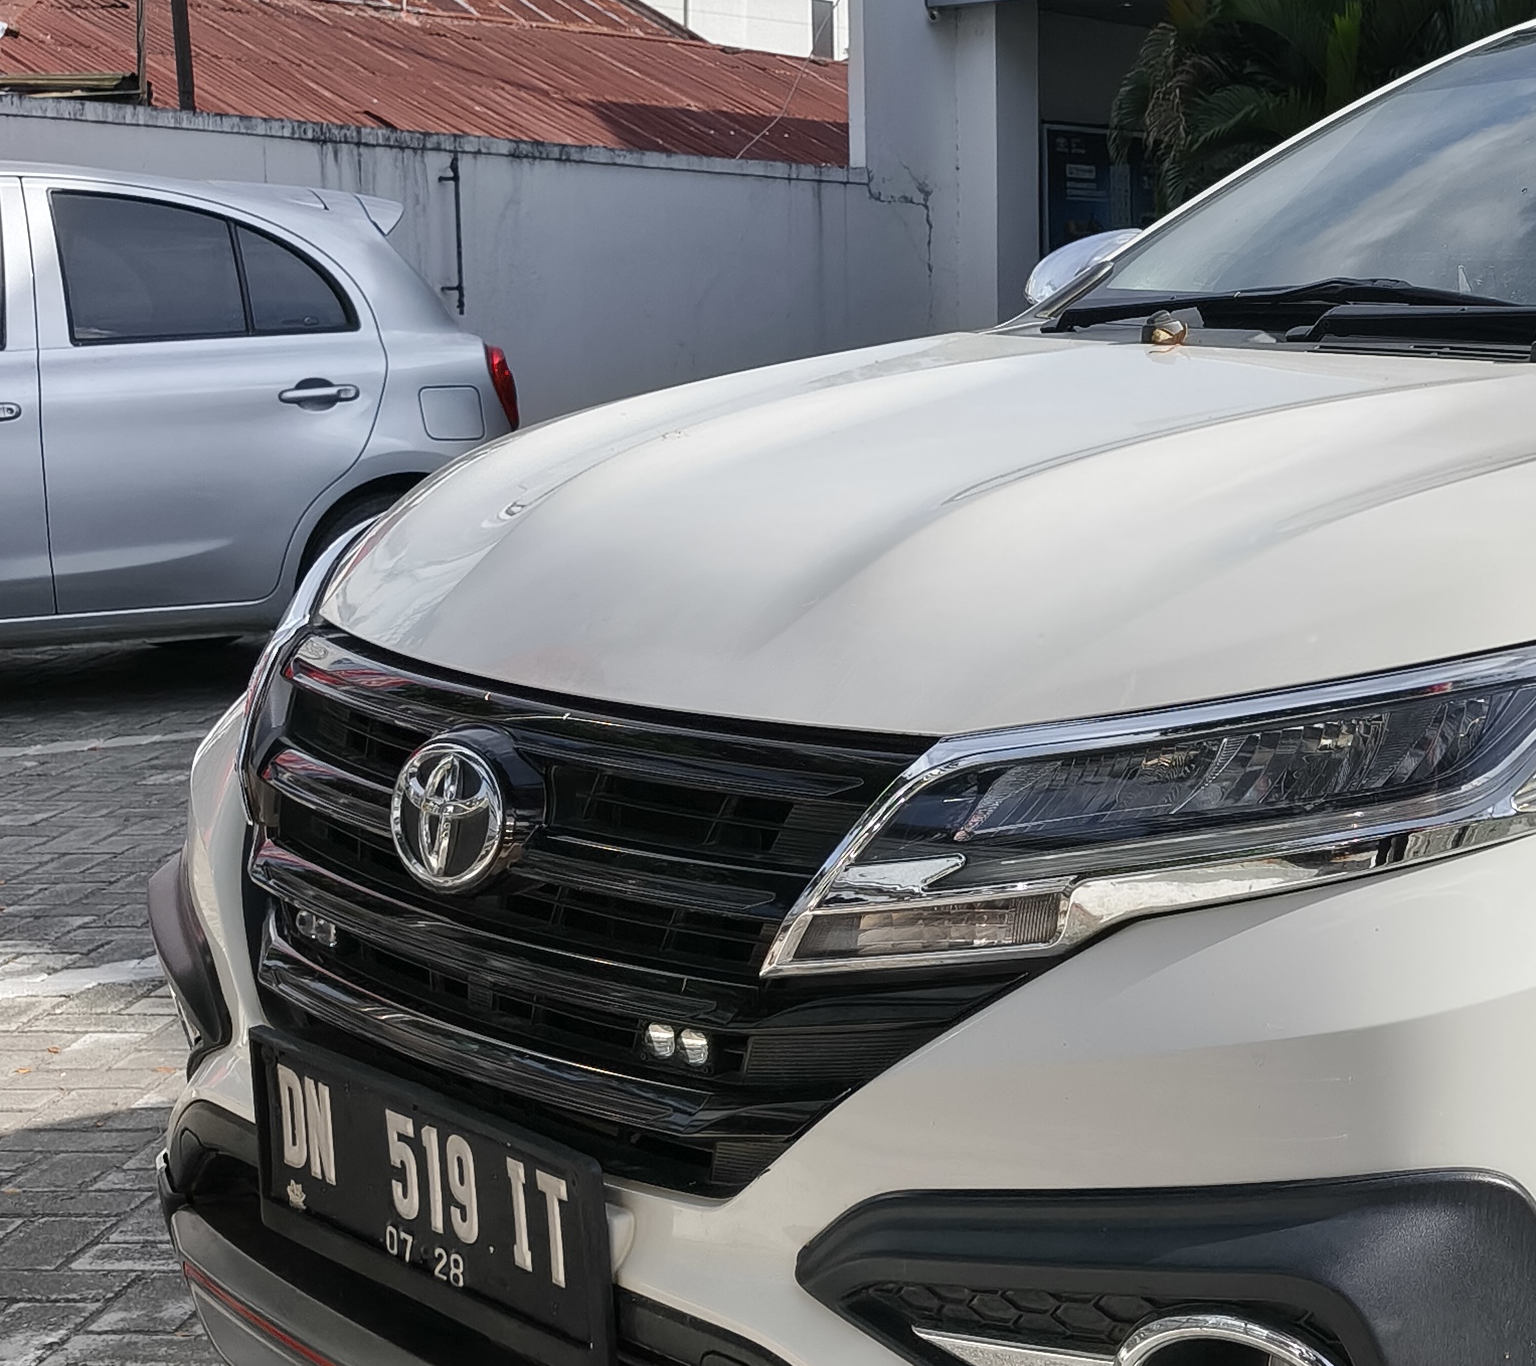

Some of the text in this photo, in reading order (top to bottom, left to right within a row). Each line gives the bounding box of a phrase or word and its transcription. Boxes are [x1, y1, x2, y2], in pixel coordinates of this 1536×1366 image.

[276, 1063, 569, 1289] DN 519 IT
[385, 1225, 465, 1288] 07 28
